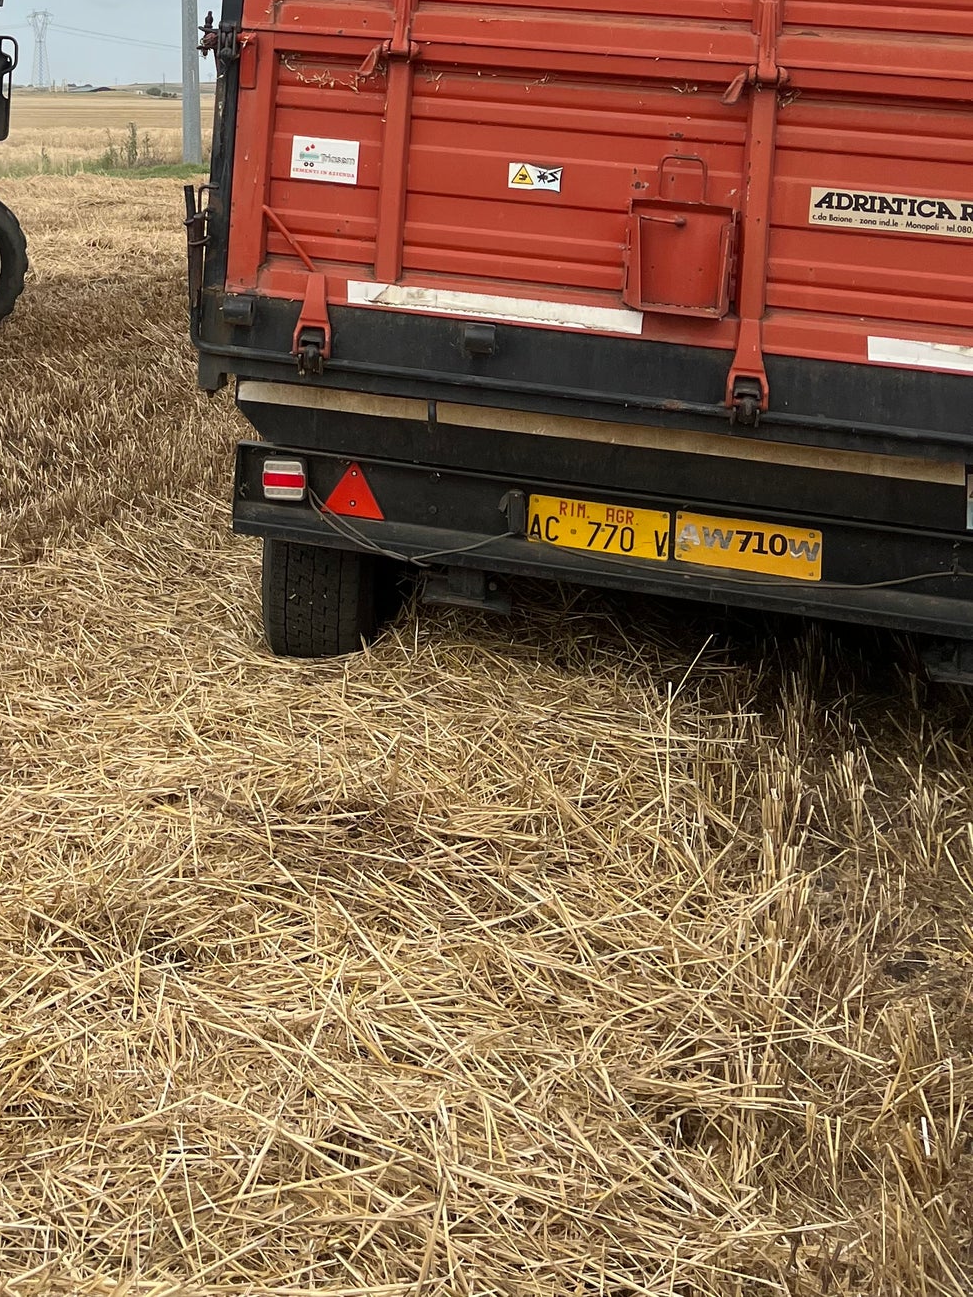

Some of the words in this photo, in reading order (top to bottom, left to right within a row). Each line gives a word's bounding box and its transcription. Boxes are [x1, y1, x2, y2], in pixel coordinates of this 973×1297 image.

[814, 191, 957, 220] ADRIATICA
[812, 212, 827, 221] c.da
[829, 213, 852, 223] Baione
[859, 217, 877, 225] zona
[878, 217, 898, 228] ind.le
[905, 220, 939, 232] Monopoli
[559, 501, 590, 520] RIM.
[606, 507, 639, 527] AGR.
[529, 513, 560, 542] AC
[587, 520, 635, 553] 770
[654, 529, 668, 558] V
[677, 522, 821, 562] AW710W
